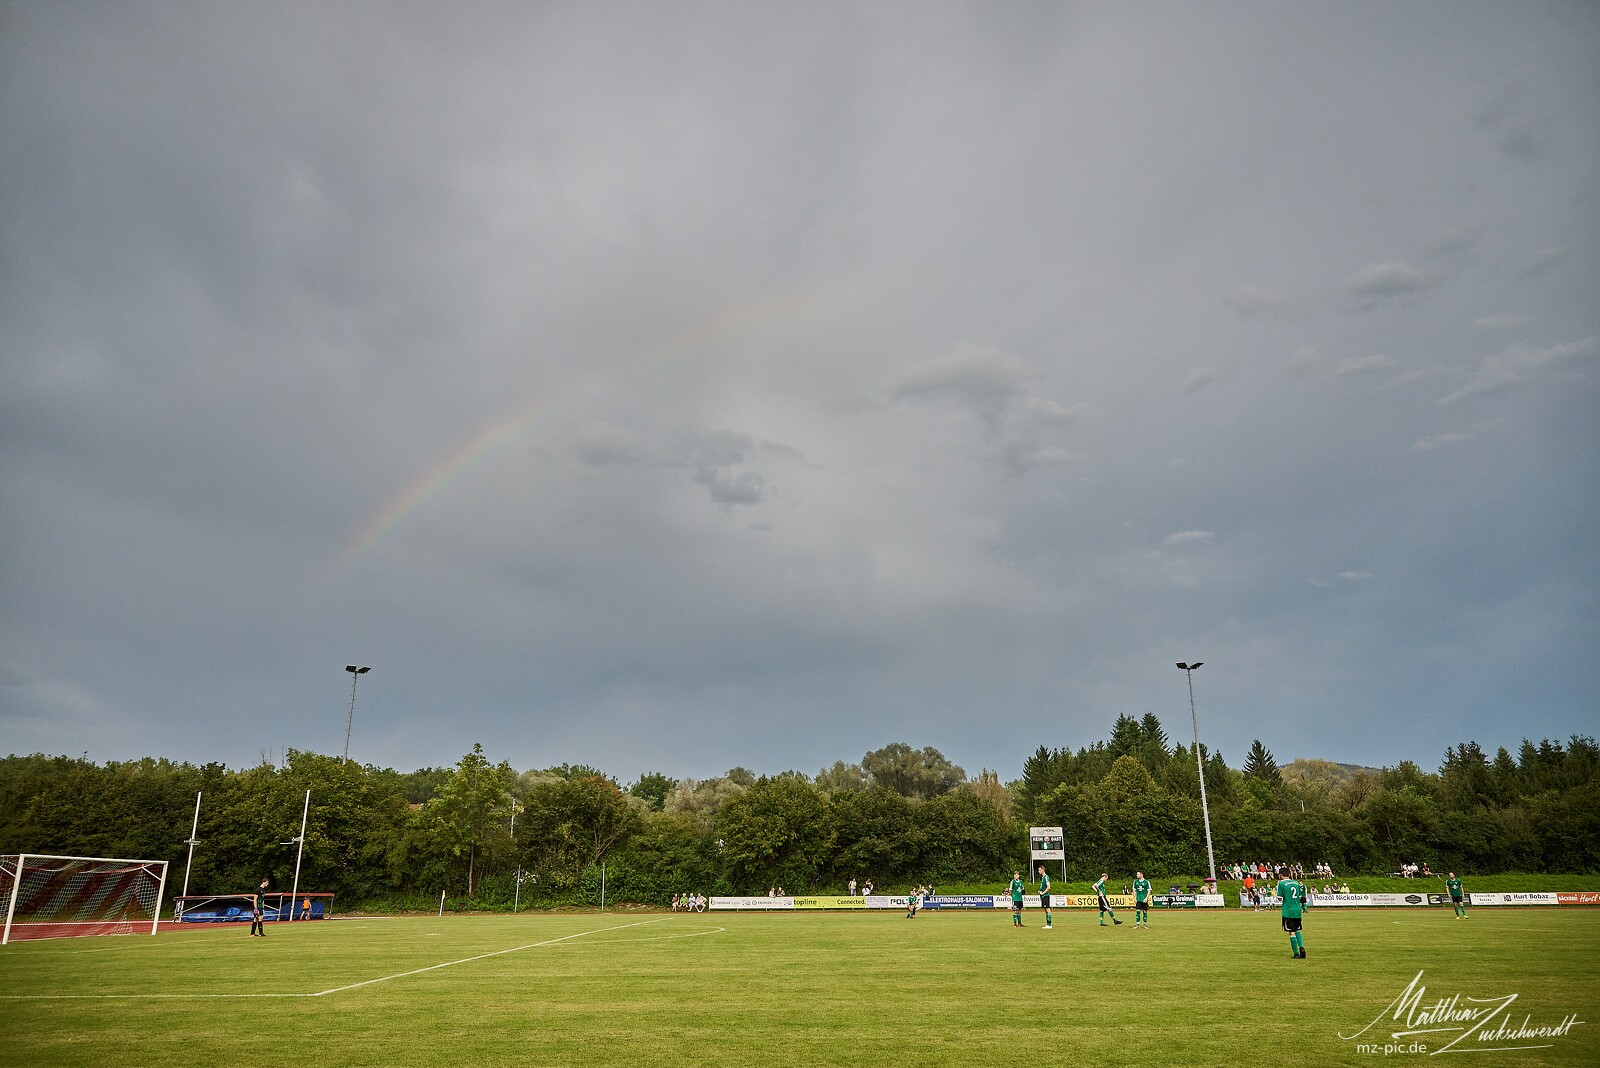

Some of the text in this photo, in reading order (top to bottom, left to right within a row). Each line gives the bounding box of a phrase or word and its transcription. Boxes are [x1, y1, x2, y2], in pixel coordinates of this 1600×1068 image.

[1290, 886, 1298, 898] 2
[793, 898, 817, 906] topline
[1109, 897, 1125, 906] BAU
